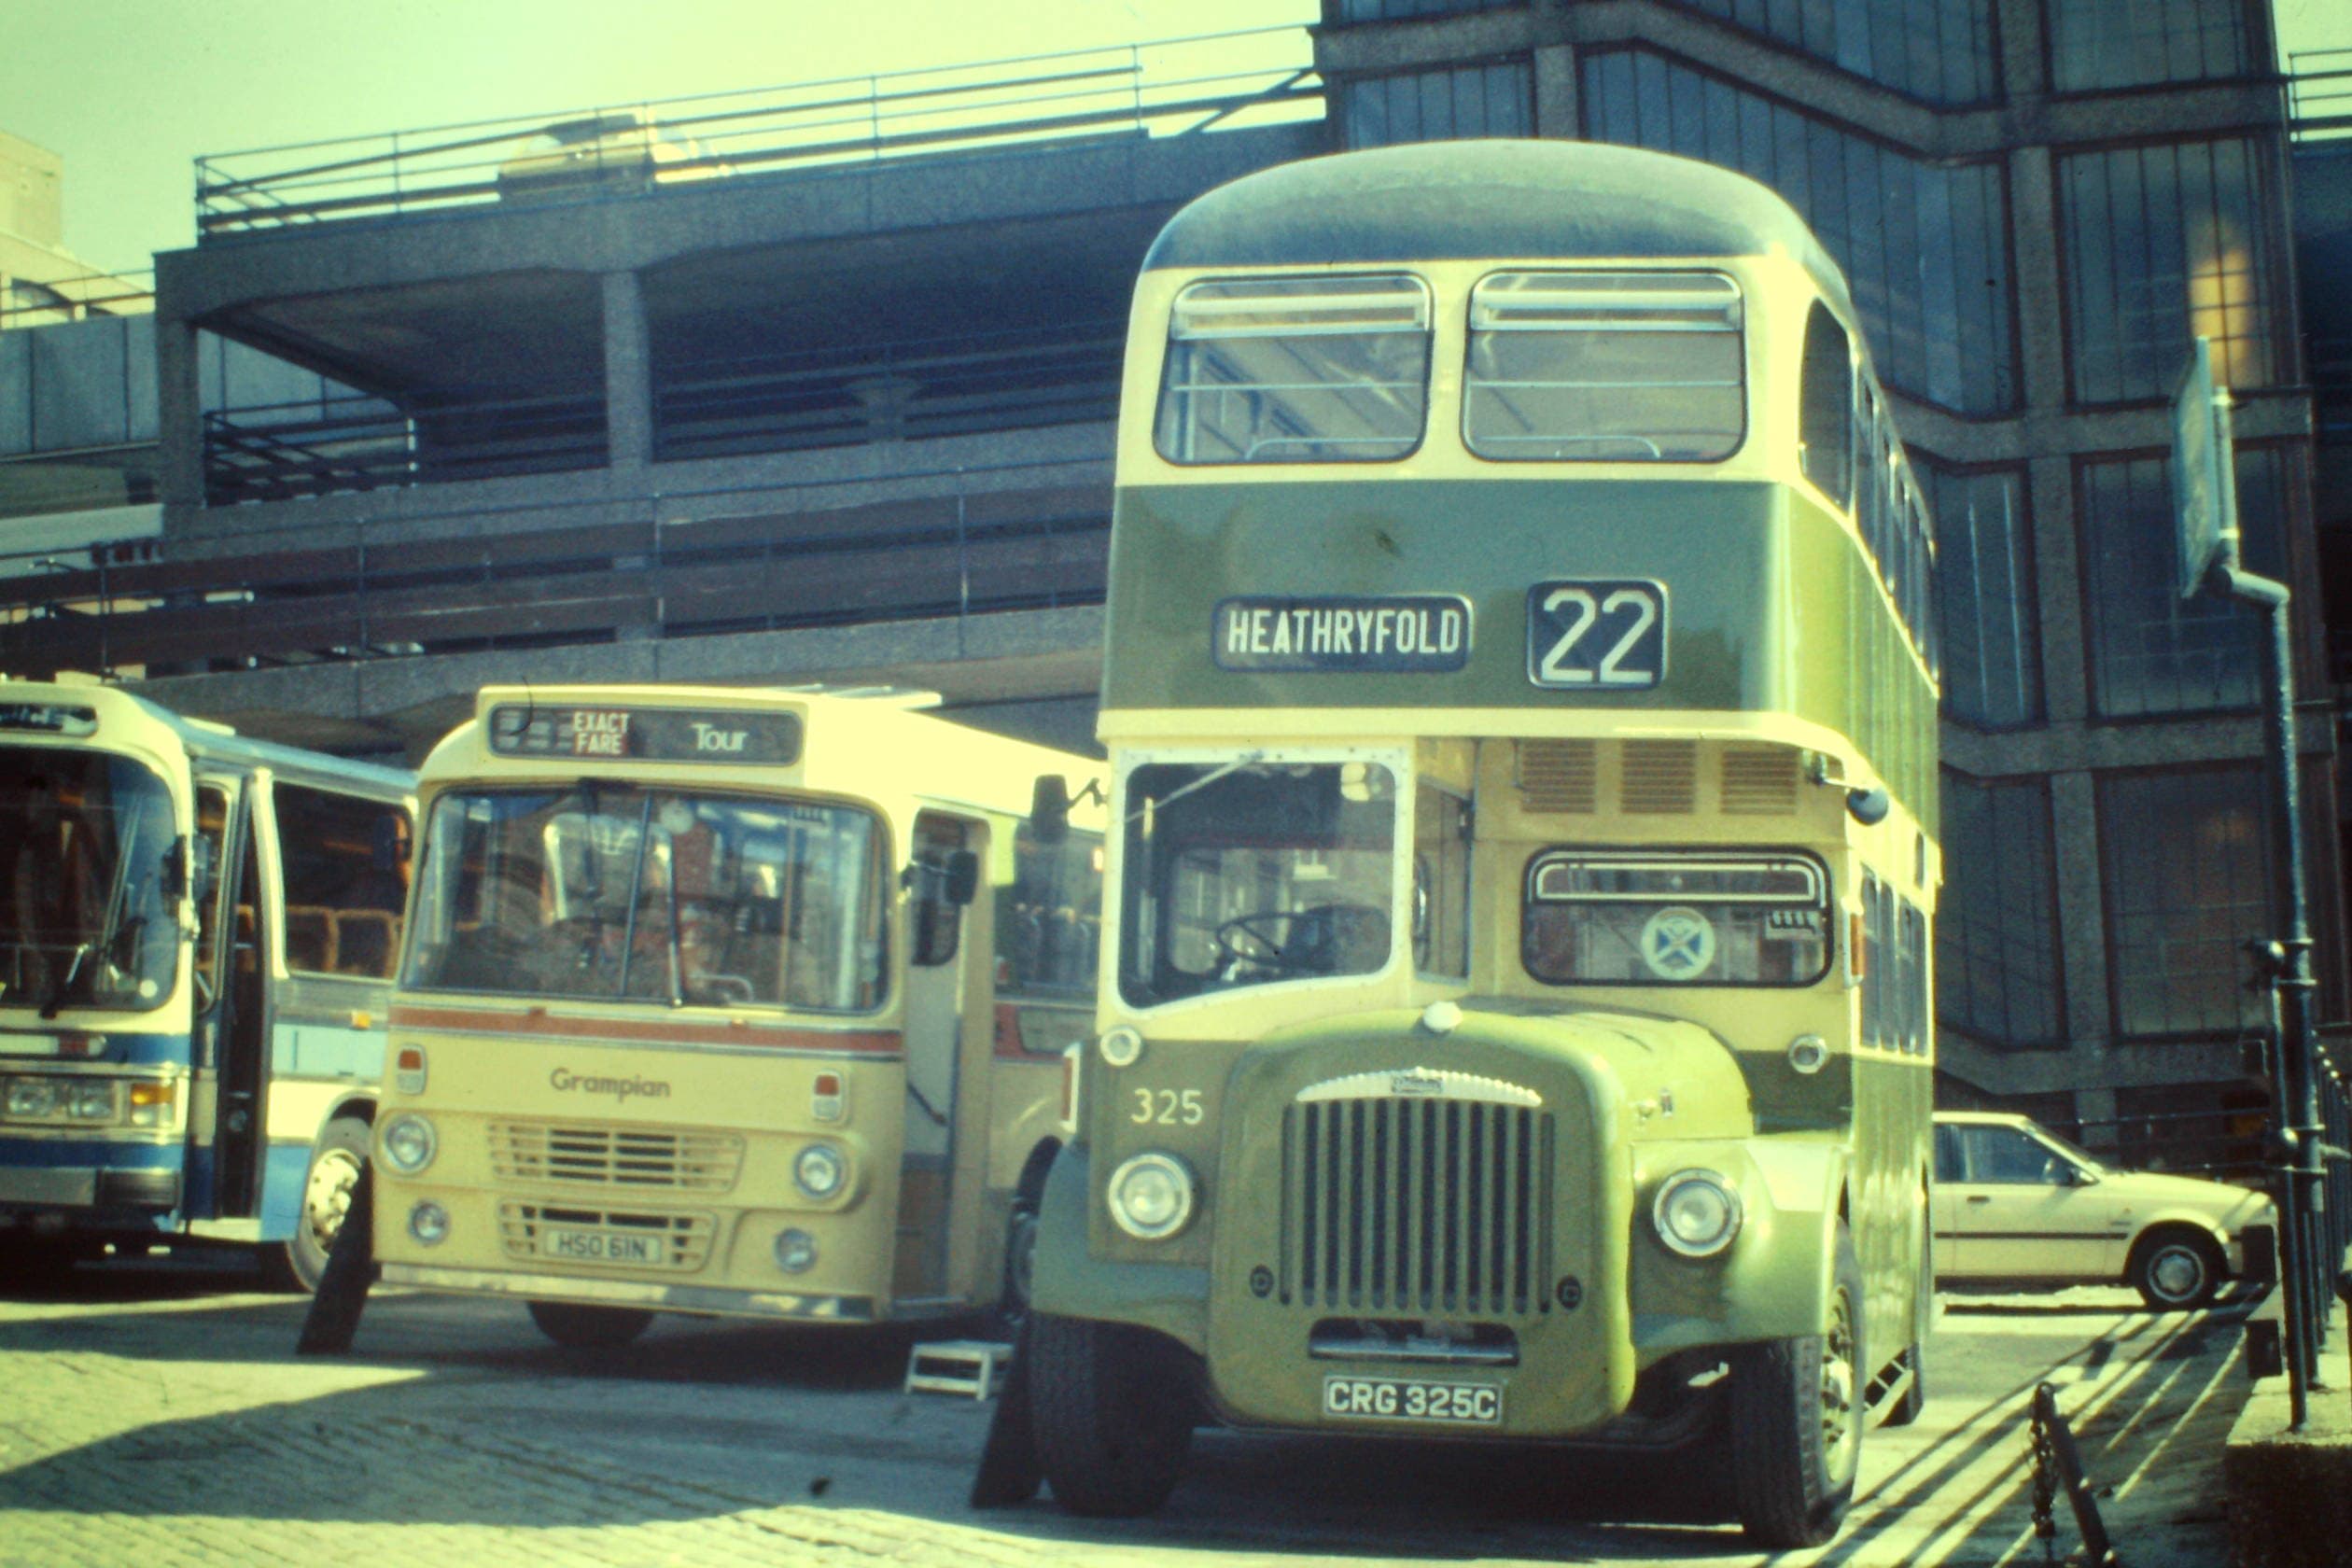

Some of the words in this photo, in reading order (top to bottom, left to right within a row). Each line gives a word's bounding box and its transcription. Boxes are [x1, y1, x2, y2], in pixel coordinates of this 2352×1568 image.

[1226, 609, 1462, 655] HEATHRYFOLD
[1540, 588, 1657, 683] 22
[573, 710, 630, 734] EXACT
[690, 722, 749, 751] Tour
[575, 732, 623, 755] FARE
[549, 1067, 672, 1104] Grampian
[1130, 1087, 1203, 1126] 325
[557, 1232, 604, 1257] HSO
[1327, 1380, 1398, 1415] CRG
[1405, 1384, 1496, 1420] 325C
